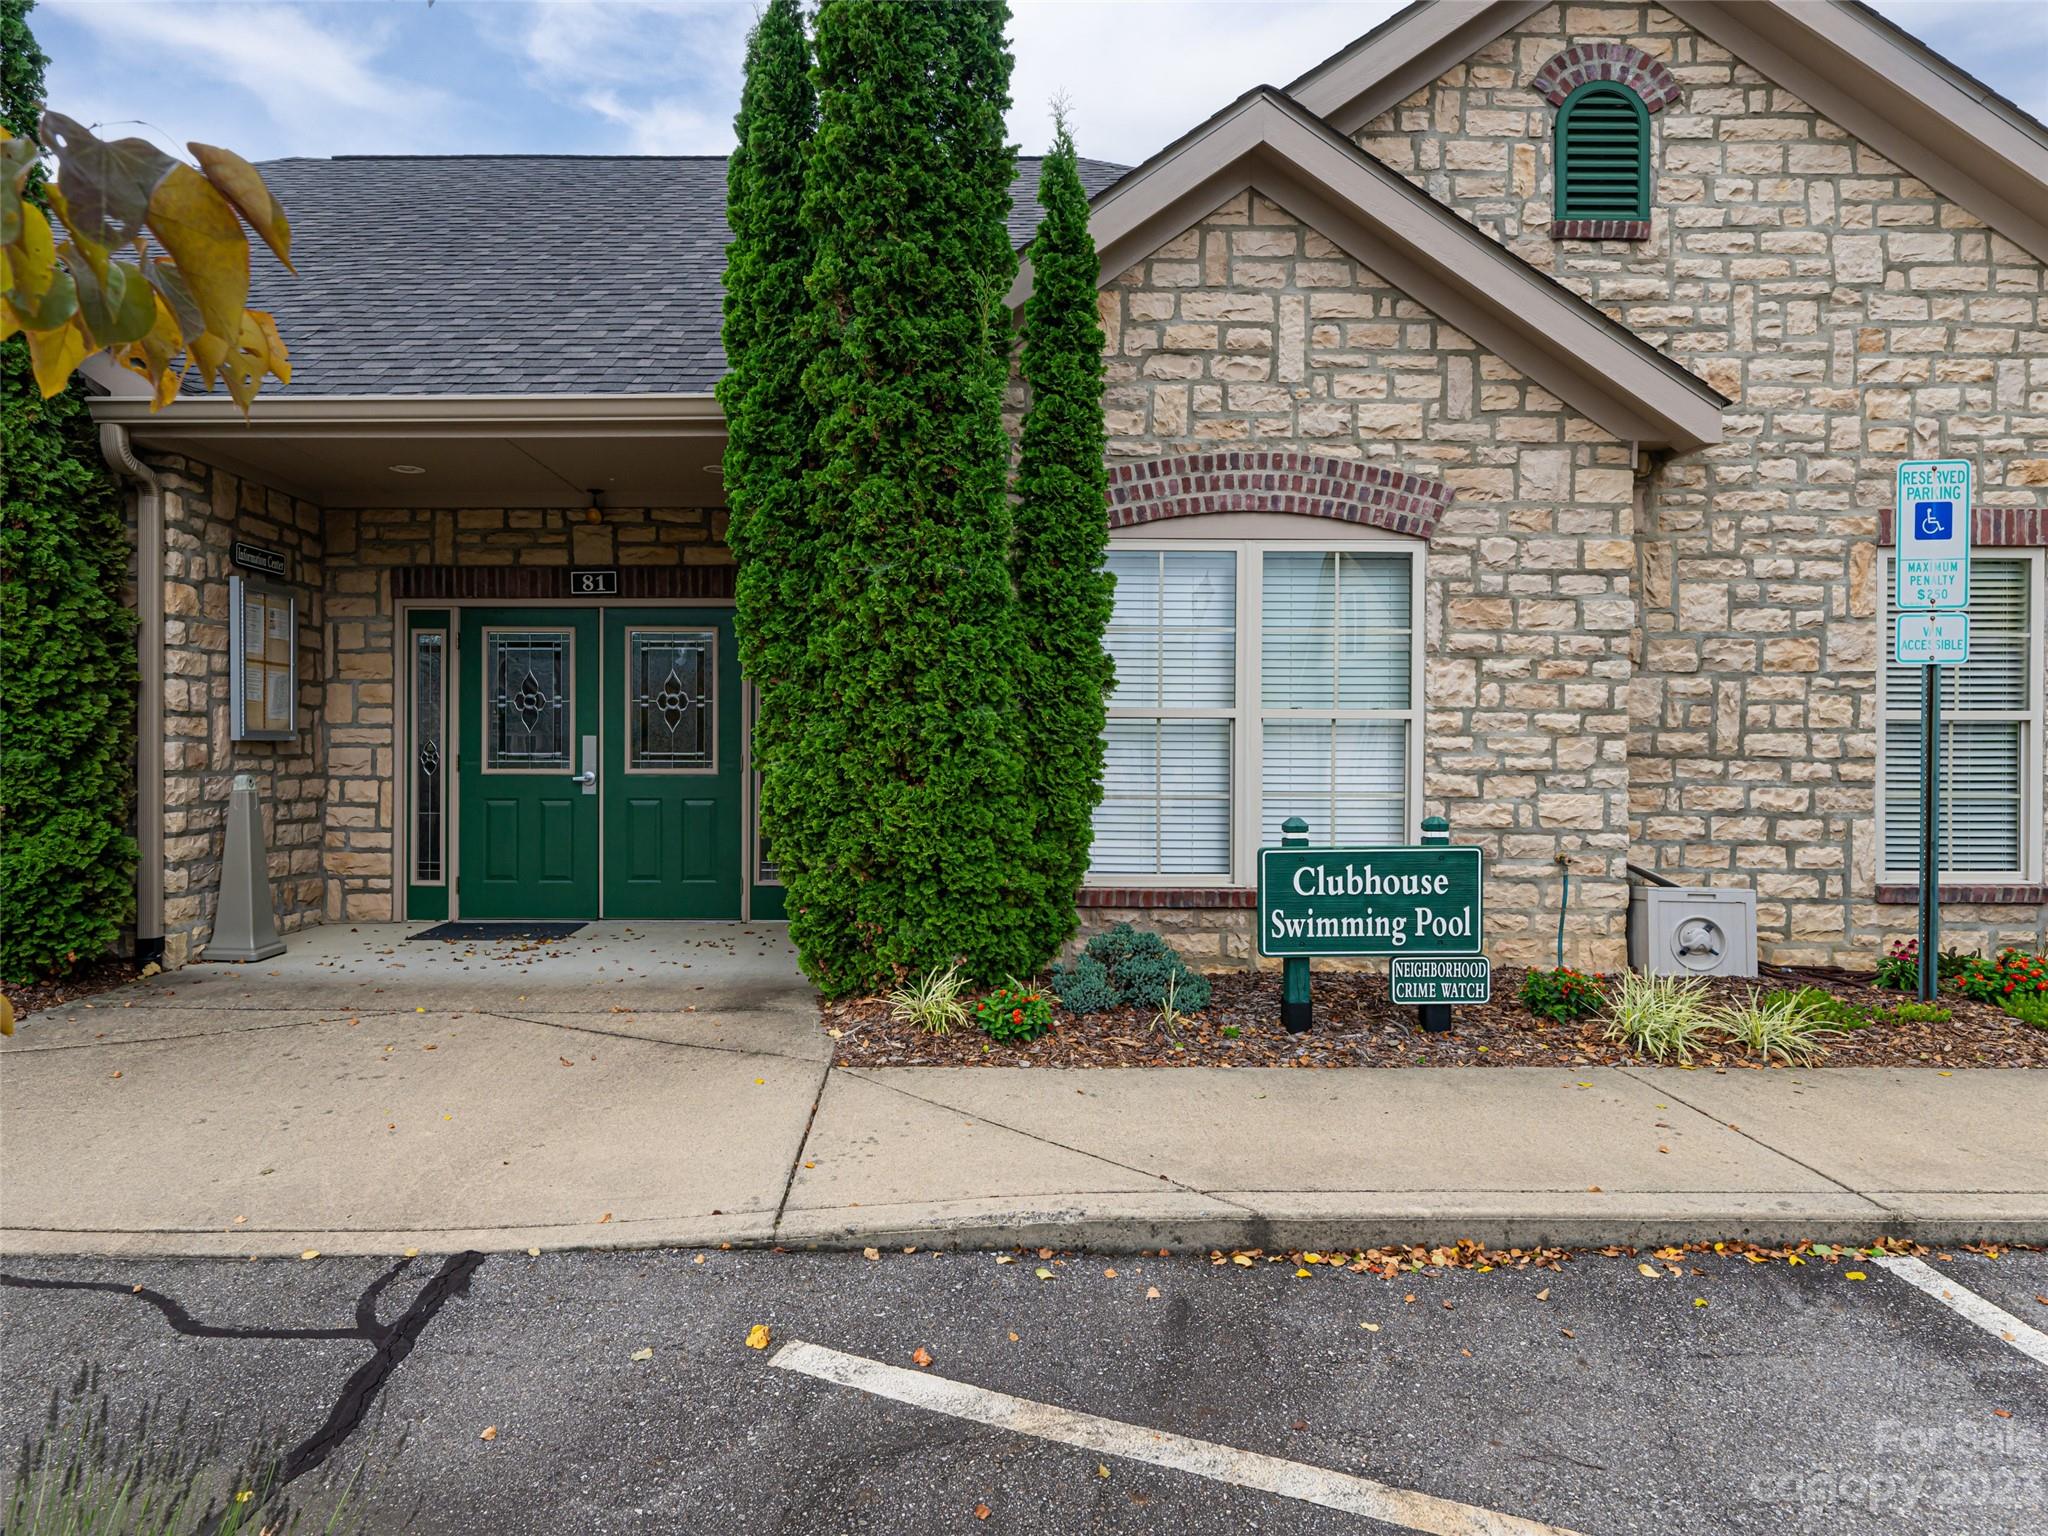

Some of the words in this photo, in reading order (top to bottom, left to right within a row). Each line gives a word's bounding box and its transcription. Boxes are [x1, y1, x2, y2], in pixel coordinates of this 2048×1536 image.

[1903, 470, 1966, 485] RESERVED
[1907, 486, 1961, 500] PARKING
[238, 546, 267, 567] Information
[268, 555, 284, 571] Center
[1908, 561, 1958, 572] MAXIMUM
[582, 574, 606, 591] 81
[1910, 575, 1955, 585] PENALTY
[1917, 589, 1948, 600] $250
[1923, 626, 1942, 637] VN
[1901, 639, 1963, 650] ACCESSIBLE
[1293, 864, 1449, 896] Clubhouse
[1271, 907, 1407, 946] Swimming
[1415, 905, 1472, 937] Pool
[1395, 962, 1487, 978] NEIGHBORHOOD
[1396, 983, 1437, 998] CRIME
[1441, 982, 1485, 998] WATCH
